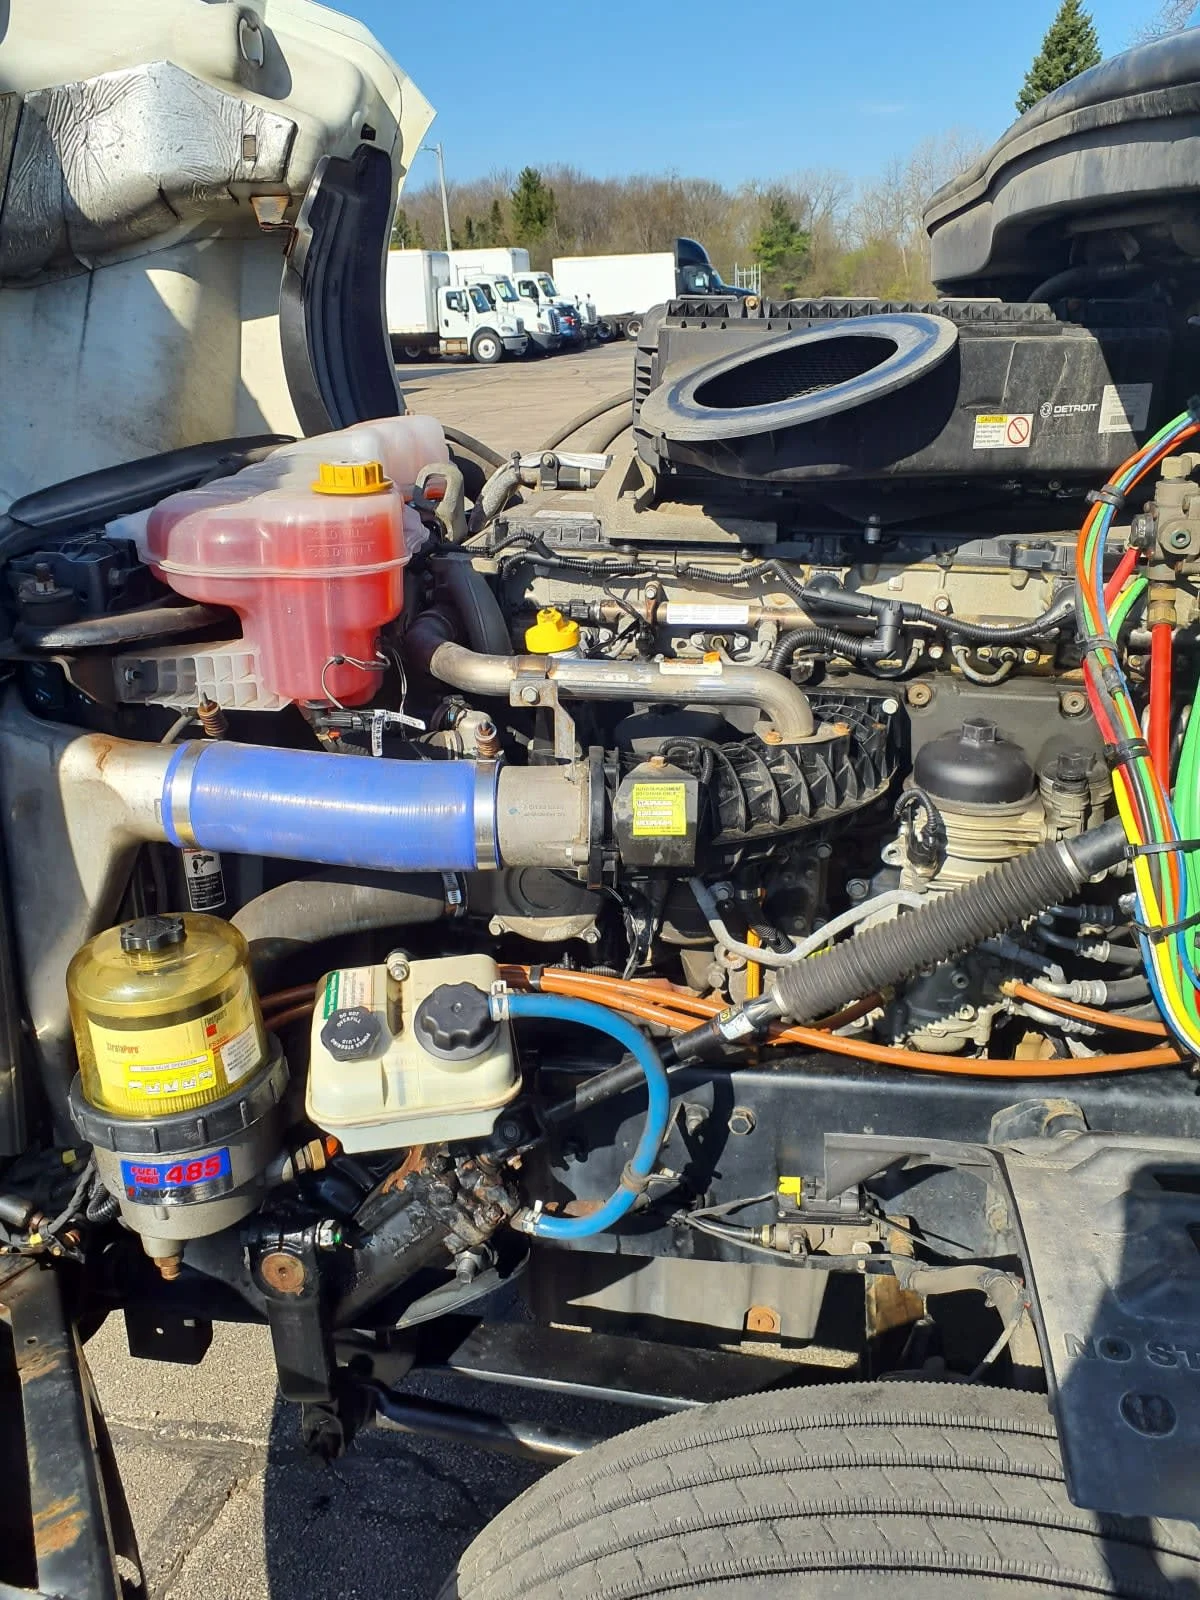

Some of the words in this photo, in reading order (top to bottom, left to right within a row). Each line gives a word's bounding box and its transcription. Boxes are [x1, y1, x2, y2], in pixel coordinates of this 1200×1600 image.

[1053, 403, 1099, 413] DETROIT
[337, 1017, 361, 1026] OVERFILL
[330, 1038, 354, 1049] STEERING
[342, 1037, 360, 1045] FLUID
[355, 1033, 370, 1047] POWER
[130, 1166, 159, 1177] FUEL
[165, 1155, 221, 1184] 485
[135, 1174, 160, 1185] PRO
[1063, 1332, 1133, 1363] NO
